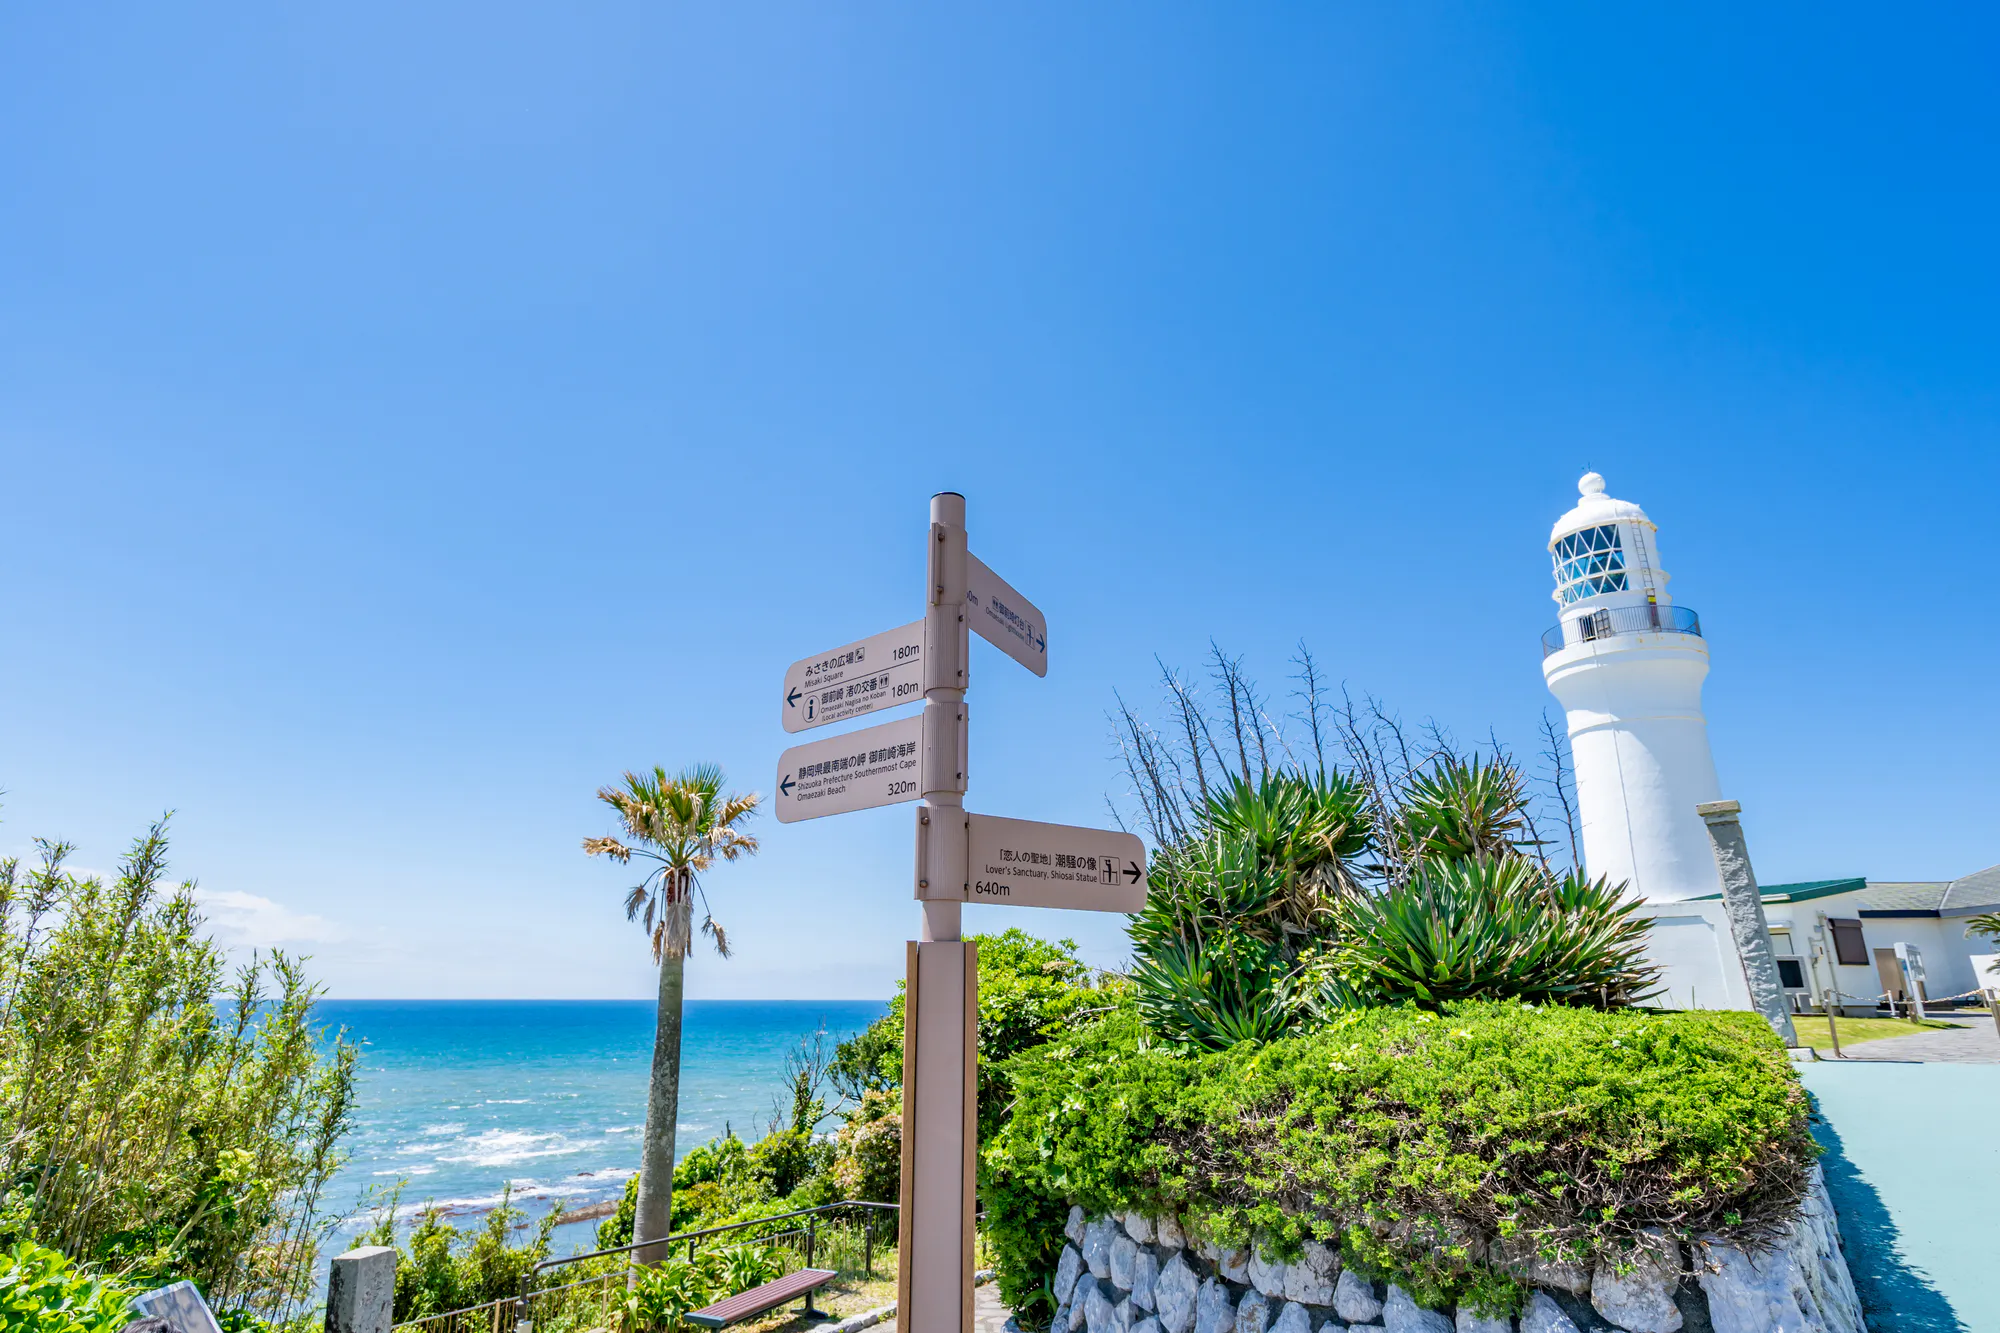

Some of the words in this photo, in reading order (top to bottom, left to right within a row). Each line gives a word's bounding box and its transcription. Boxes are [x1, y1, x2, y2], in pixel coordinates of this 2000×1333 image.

[966, 590, 979, 606] 0m
[893, 645, 920, 661] 180m
[805, 651, 855, 677] みさきの広場
[804, 676, 823, 688] Misaki
[823, 671, 844, 683] Square
[846, 677, 878, 698] 渚の交番
[892, 683, 919, 698] 180m
[821, 702, 844, 714] Omaezaki
[845, 698, 862, 707] Nagisa
[870, 690, 887, 700] Koban
[837, 707, 855, 718] activity
[798, 753, 867, 780] 静岡県最南端の岬
[869, 741, 916, 764] 御前崎海岸
[798, 780, 822, 791] Shizuoka
[823, 773, 854, 785] Prefecture
[854, 763, 898, 779] Southernmost
[899, 759, 917, 770] Cape
[797, 789, 826, 801] Omaezaki
[827, 784, 846, 796] Beach
[888, 780, 917, 796] 320m
[1055, 853, 1098, 871] 潮騒の像
[985, 864, 1011, 876] Lover's
[1050, 870, 1075, 881] Shiosai
[1075, 872, 1098, 883] Statue
[975, 880, 1010, 896] 640m
